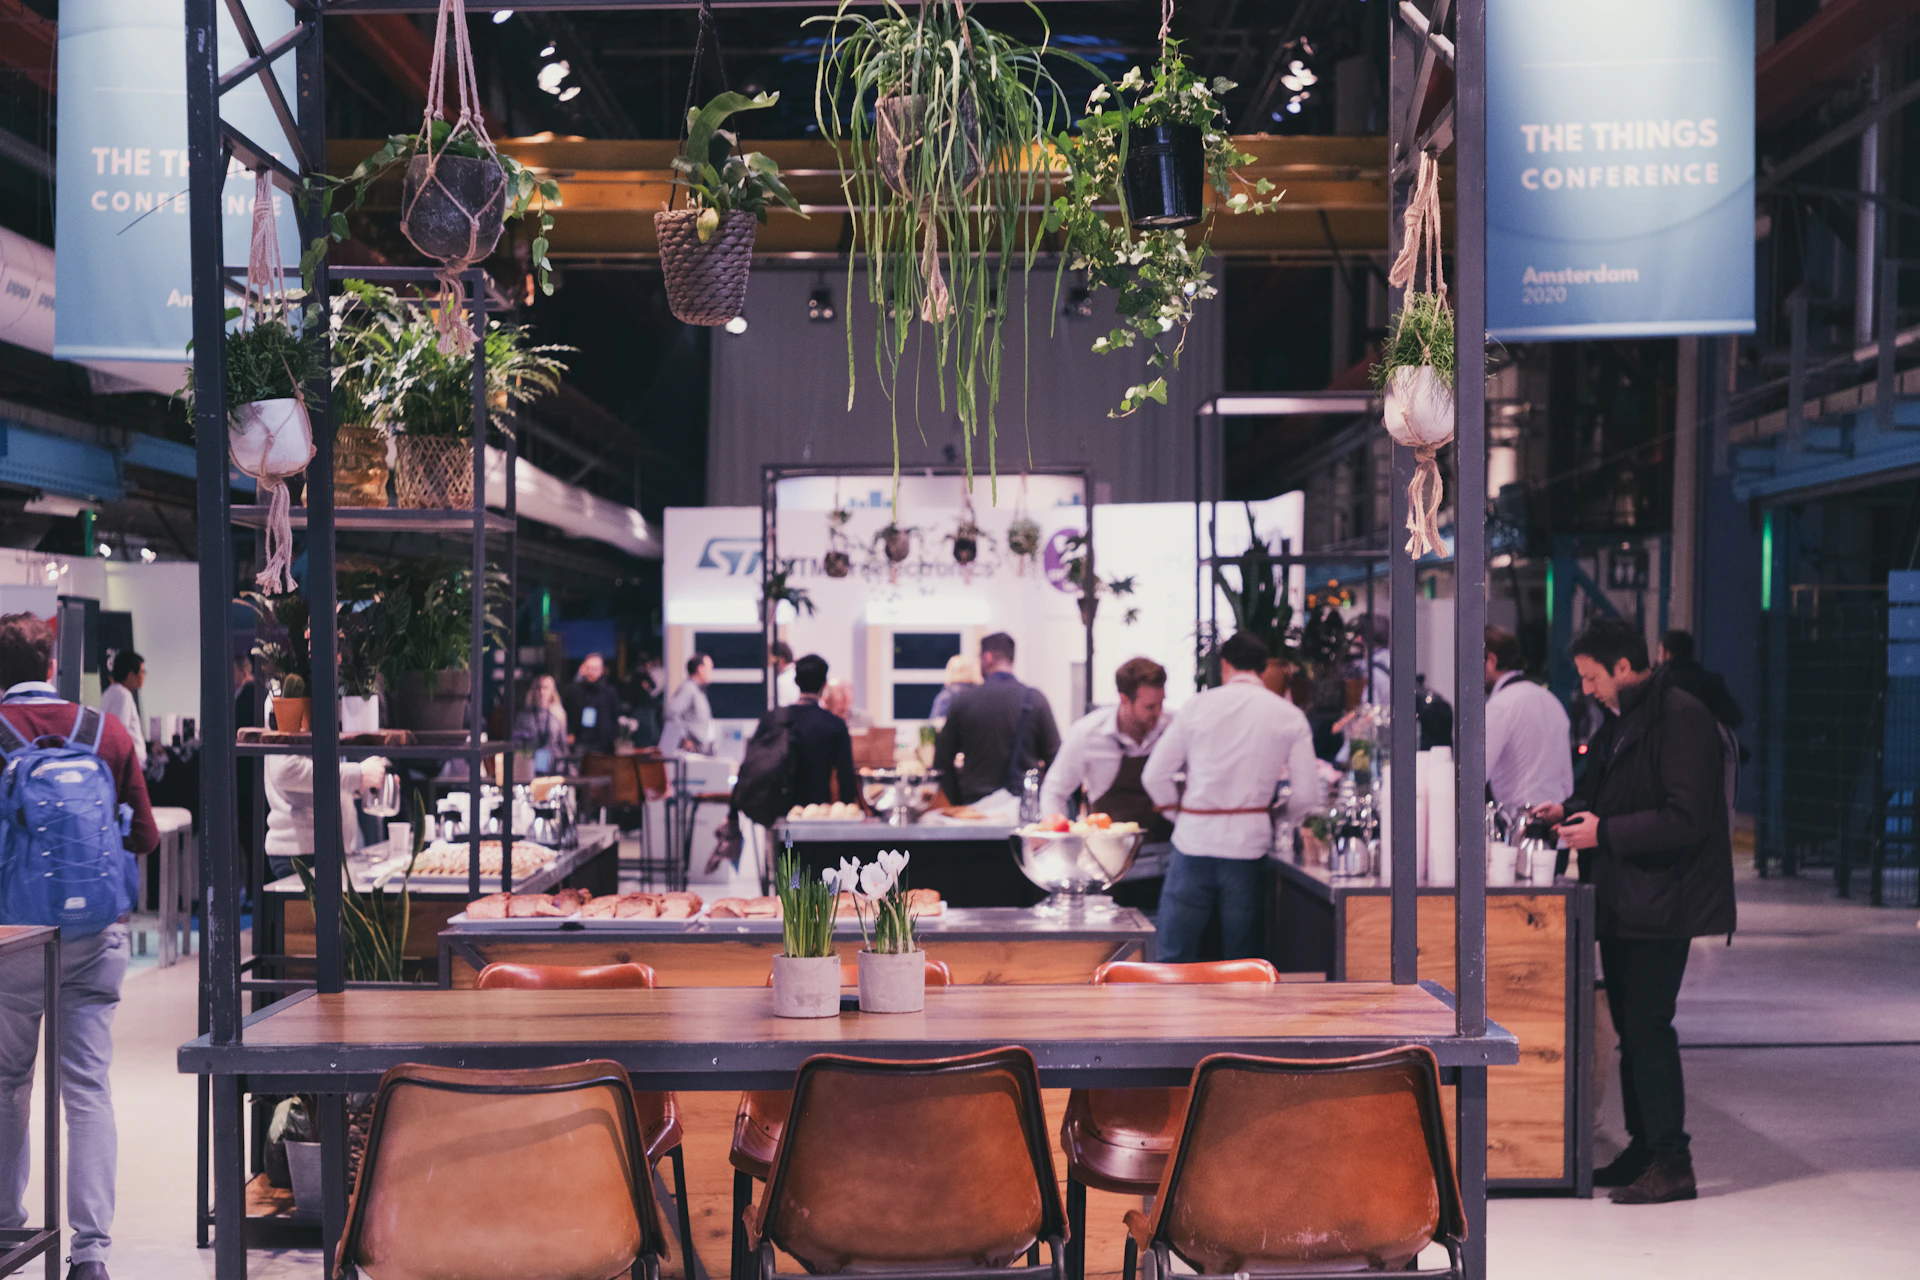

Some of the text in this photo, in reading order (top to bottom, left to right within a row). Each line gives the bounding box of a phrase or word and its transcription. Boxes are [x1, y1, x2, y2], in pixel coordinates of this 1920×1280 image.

[1520, 119, 1719, 153] THE THINGS
[91, 147, 151, 176] THE
[1521, 163, 1719, 190] CONFERENCE
[91, 191, 282, 217] CONFENE
[1523, 263, 1639, 284] Amsterdam
[1523, 286, 1567, 304] 2020
